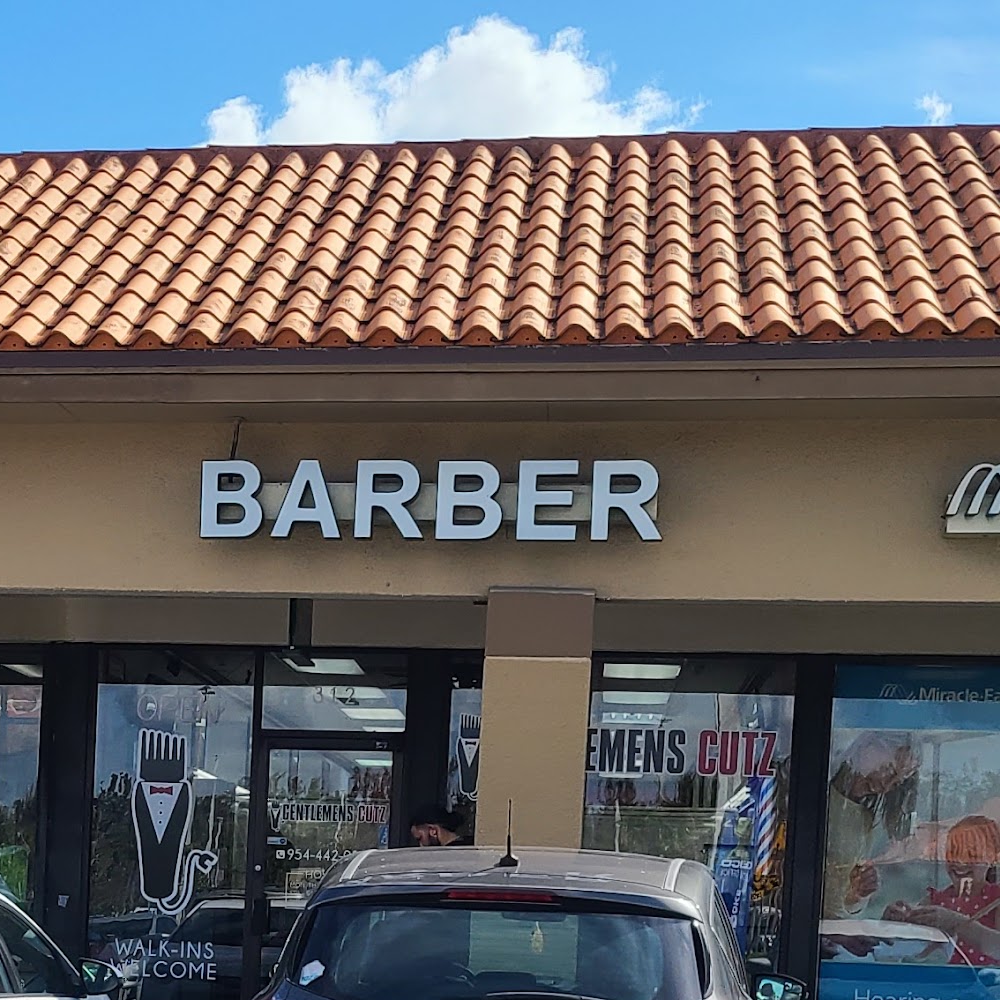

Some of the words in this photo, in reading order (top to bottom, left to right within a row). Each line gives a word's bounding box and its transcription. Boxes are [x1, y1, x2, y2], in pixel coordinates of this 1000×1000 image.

[200, 459, 663, 540] BARBER
[312, 685, 356, 705] 312
[698, 729, 778, 778] CUTZ
[282, 803, 354, 822] GENTLEMENS
[359, 804, 387, 823] CUTZ
[114, 938, 214, 960] WALK-INS
